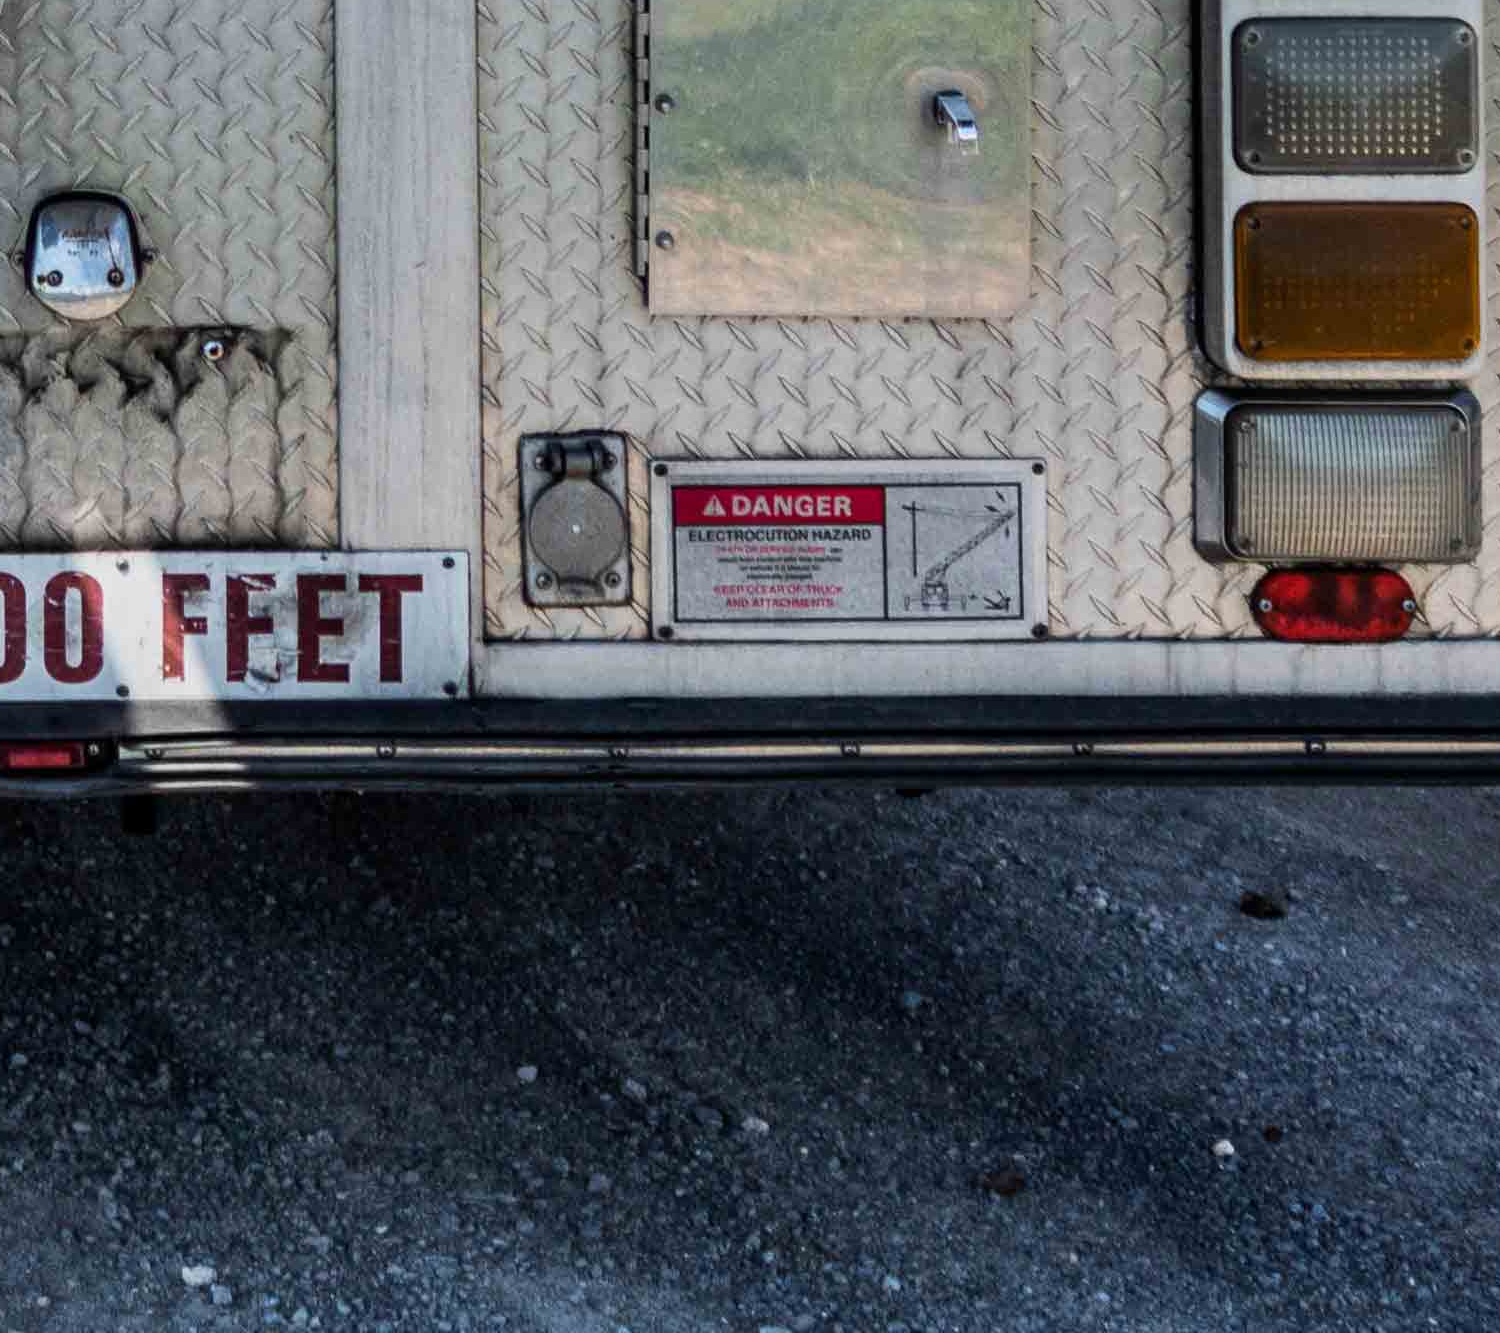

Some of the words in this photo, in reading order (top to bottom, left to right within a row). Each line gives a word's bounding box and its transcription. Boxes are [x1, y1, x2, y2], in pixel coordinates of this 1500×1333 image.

[731, 495, 853, 517] DANGER
[688, 529, 809, 542] ELECTROCUTION
[812, 529, 872, 542] HAZARD
[162, 573, 424, 683] FEET
